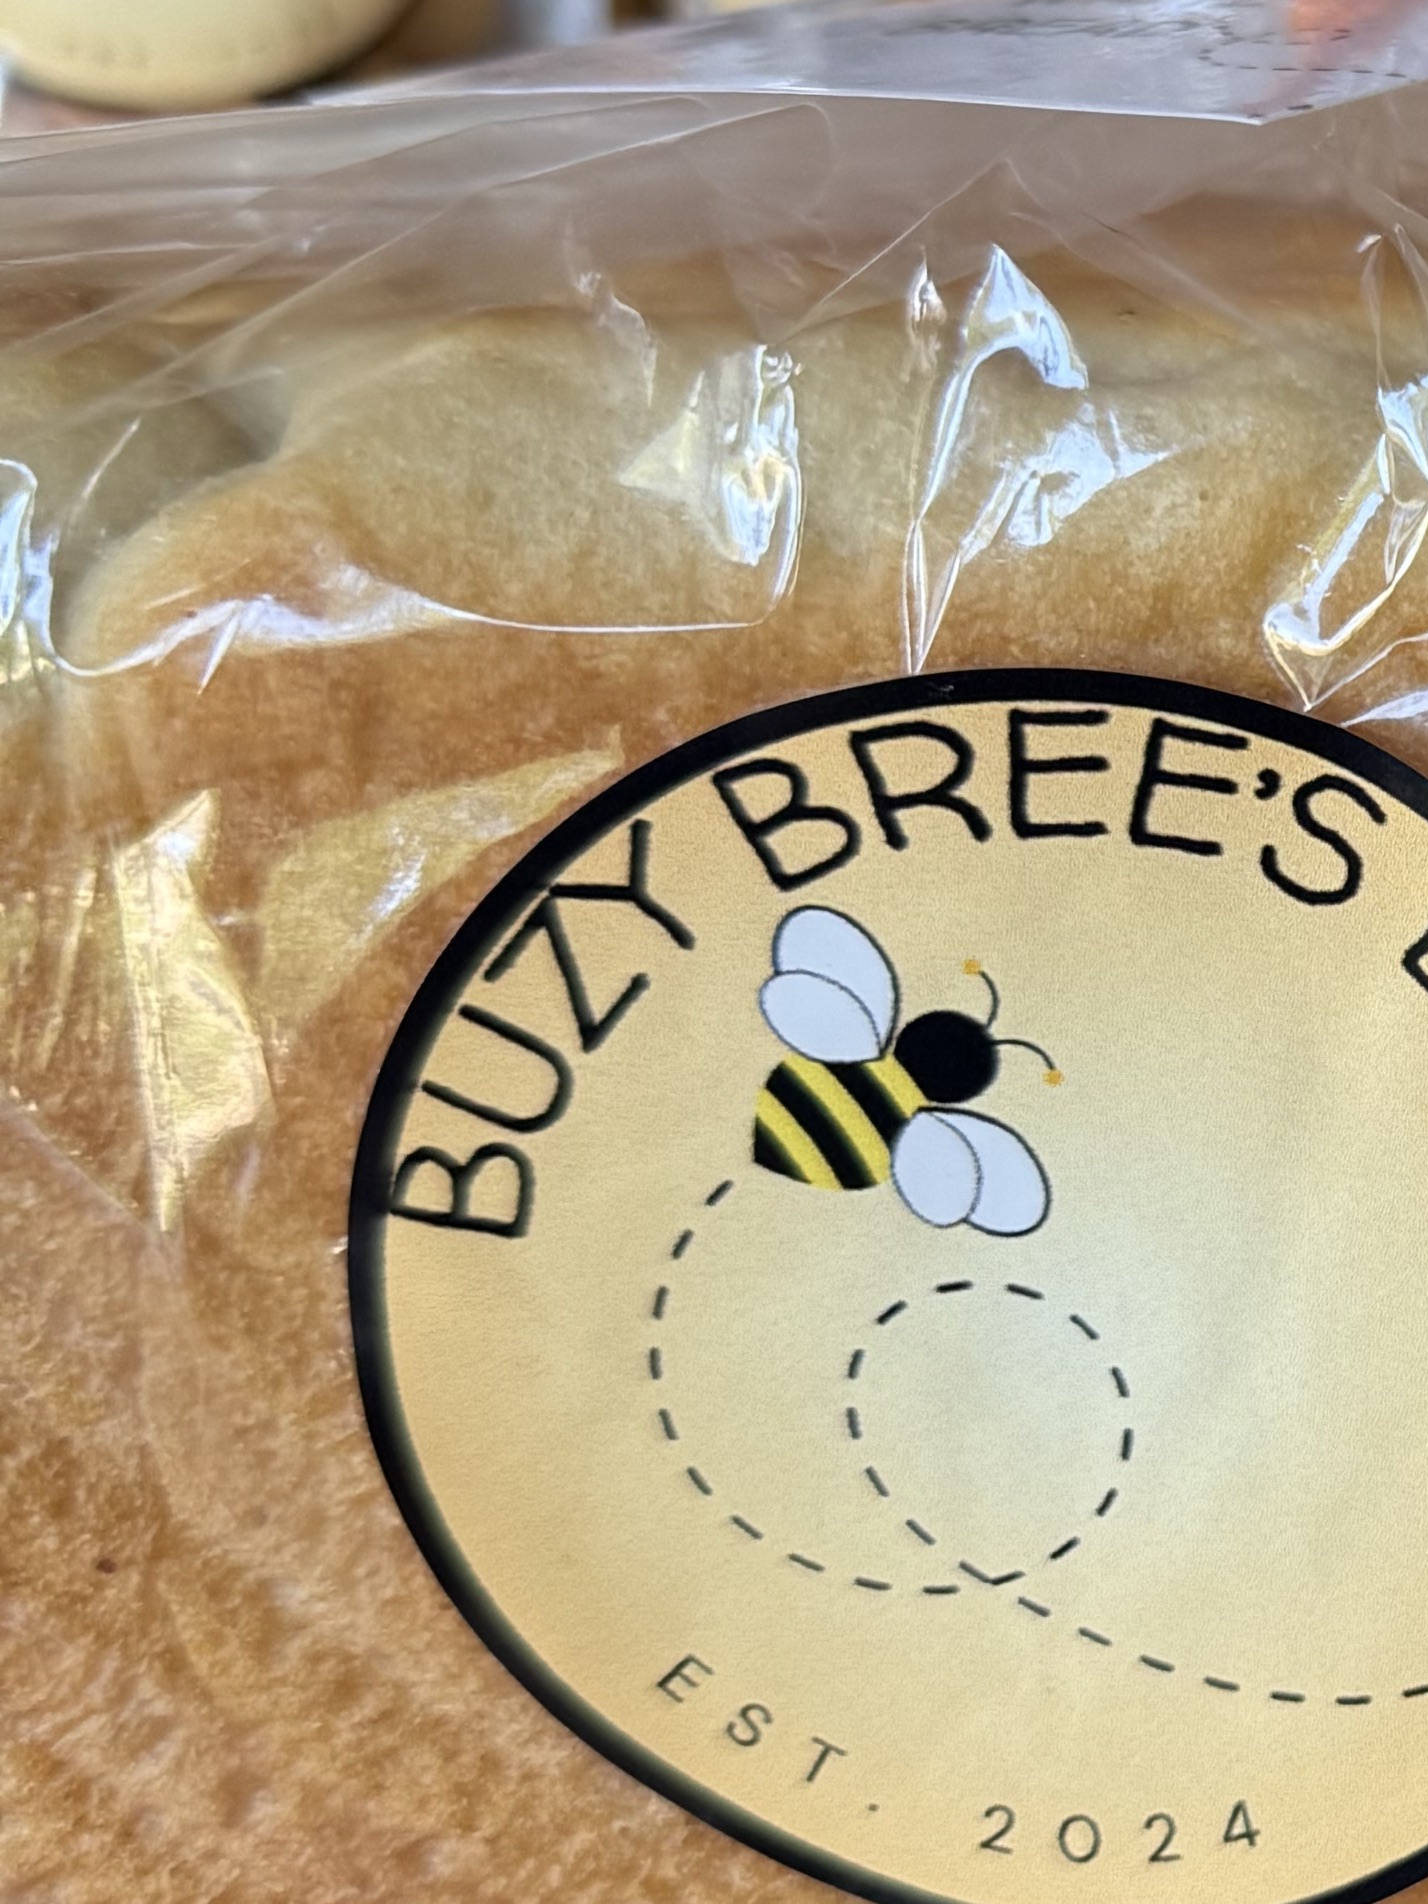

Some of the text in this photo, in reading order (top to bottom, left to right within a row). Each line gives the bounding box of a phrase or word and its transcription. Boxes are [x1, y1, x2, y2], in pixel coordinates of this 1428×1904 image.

[390, 820, 696, 1237] BUZY
[715, 708, 1387, 907] BREE'S
[655, 1653, 1263, 1865] EST. 2024
